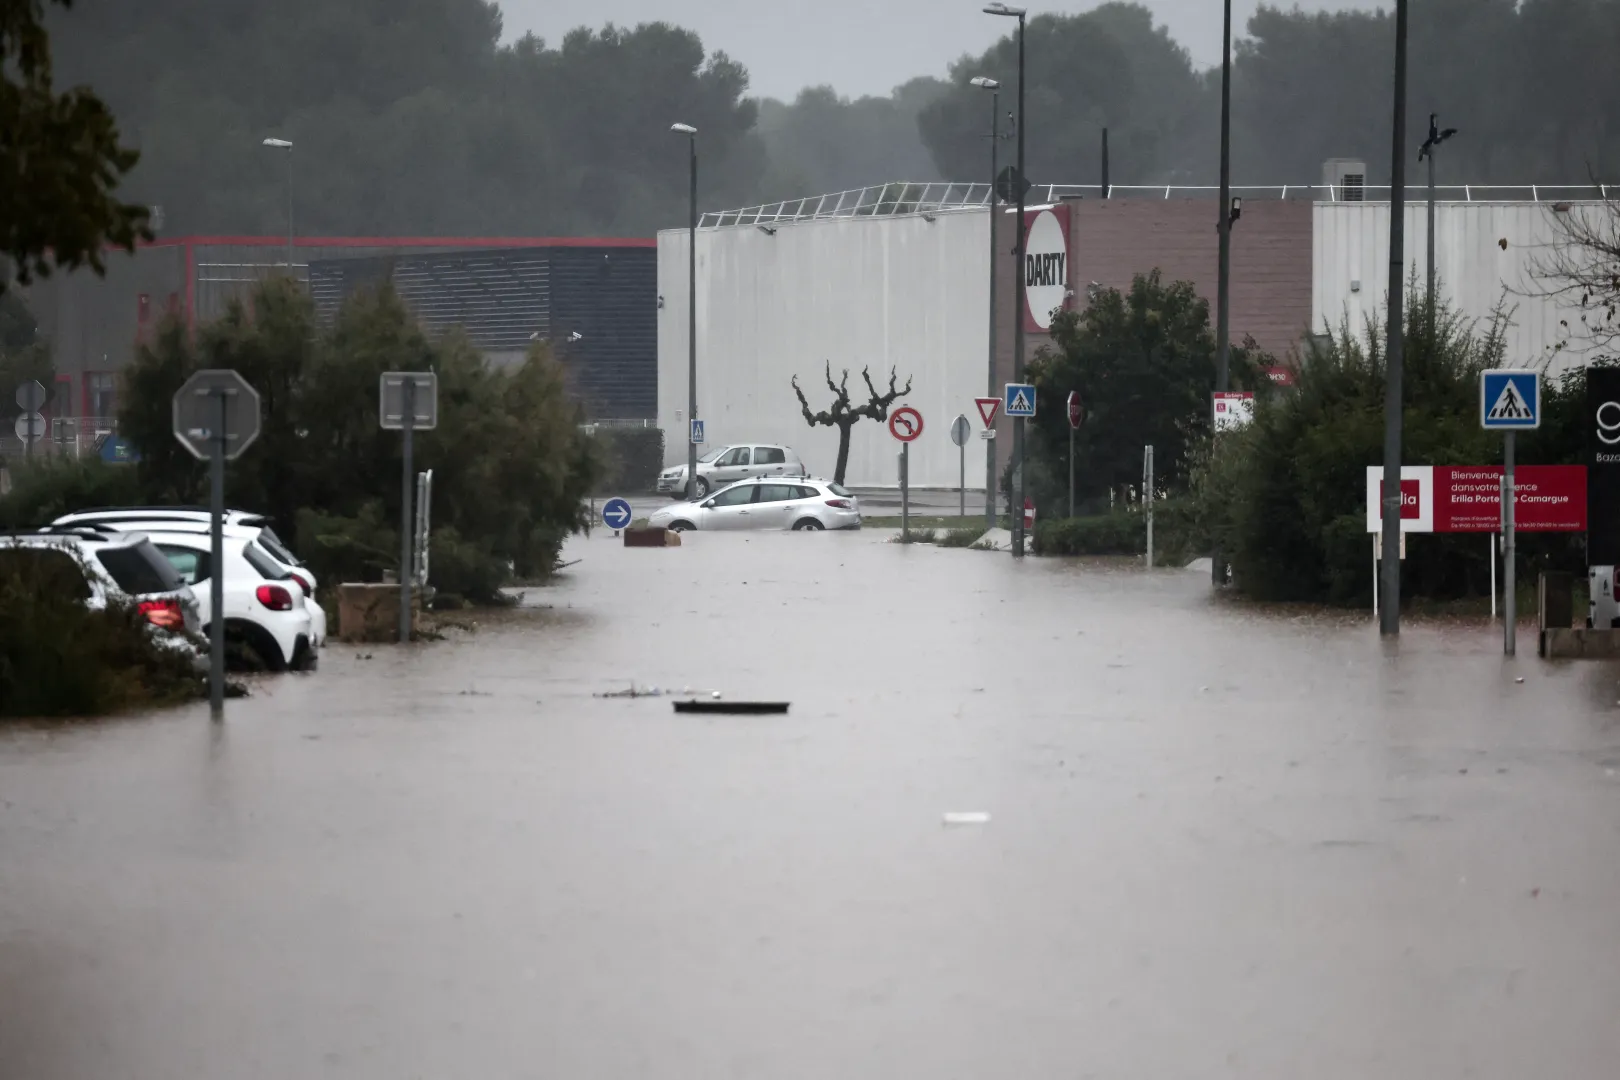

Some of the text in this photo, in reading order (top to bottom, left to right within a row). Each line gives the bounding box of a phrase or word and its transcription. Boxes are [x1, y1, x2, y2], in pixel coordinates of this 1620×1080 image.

[1026, 252, 1065, 286] DARTY
[1451, 471, 1499, 480] Bienvenue
[1451, 483, 1474, 492] dans
[1475, 484, 1499, 492] votre
[1475, 495, 1499, 503] Porte
[1520, 494, 1569, 504] Camargue
